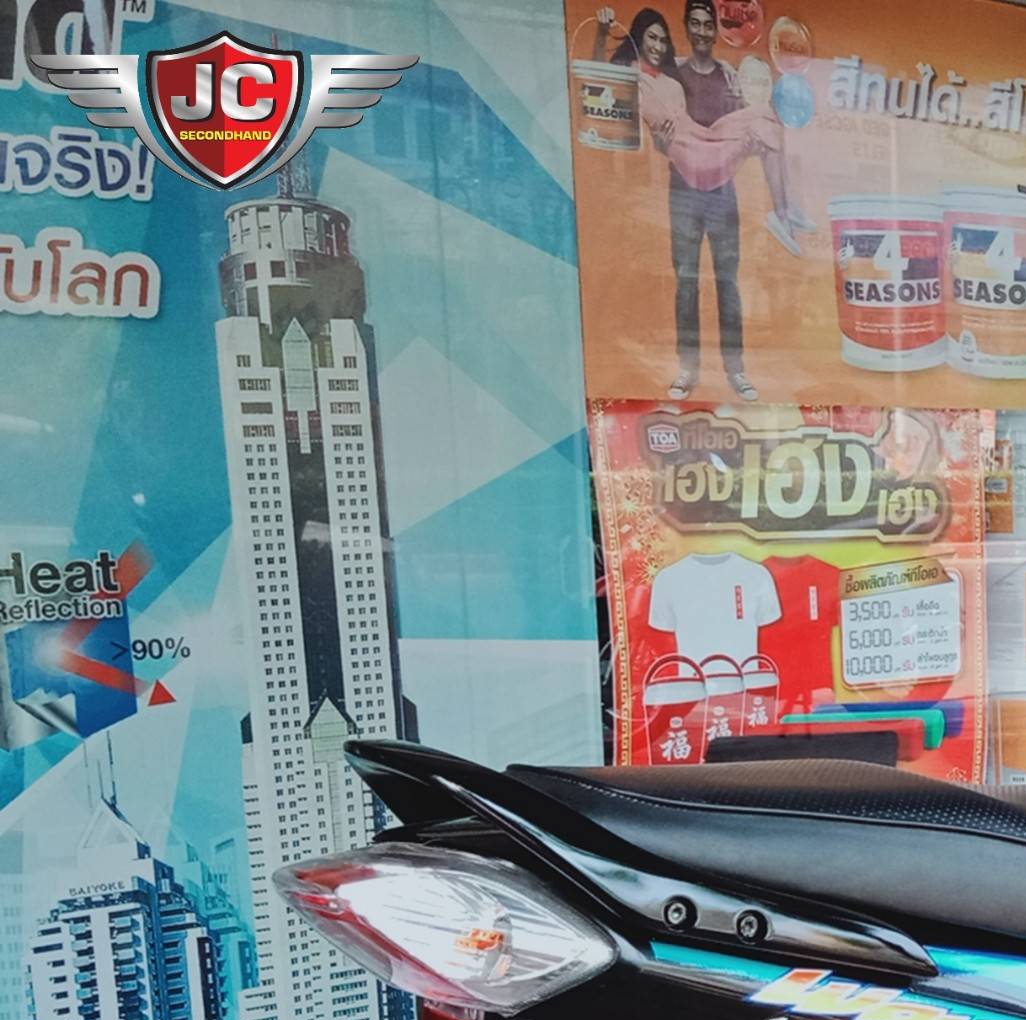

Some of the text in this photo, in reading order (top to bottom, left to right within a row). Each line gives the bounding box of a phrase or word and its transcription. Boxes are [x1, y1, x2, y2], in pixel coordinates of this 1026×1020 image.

[873, 233, 908, 281] 4
[986, 228, 1022, 282] 4
[845, 280, 941, 303] SEASONS
[650, 430, 679, 446] TOA
[0, 552, 119, 595] Heat
[849, 600, 892, 623] 3,500
[849, 628, 892, 650] 6,000
[846, 655, 893, 677] 10,000
[659, 731, 692, 761] 福
